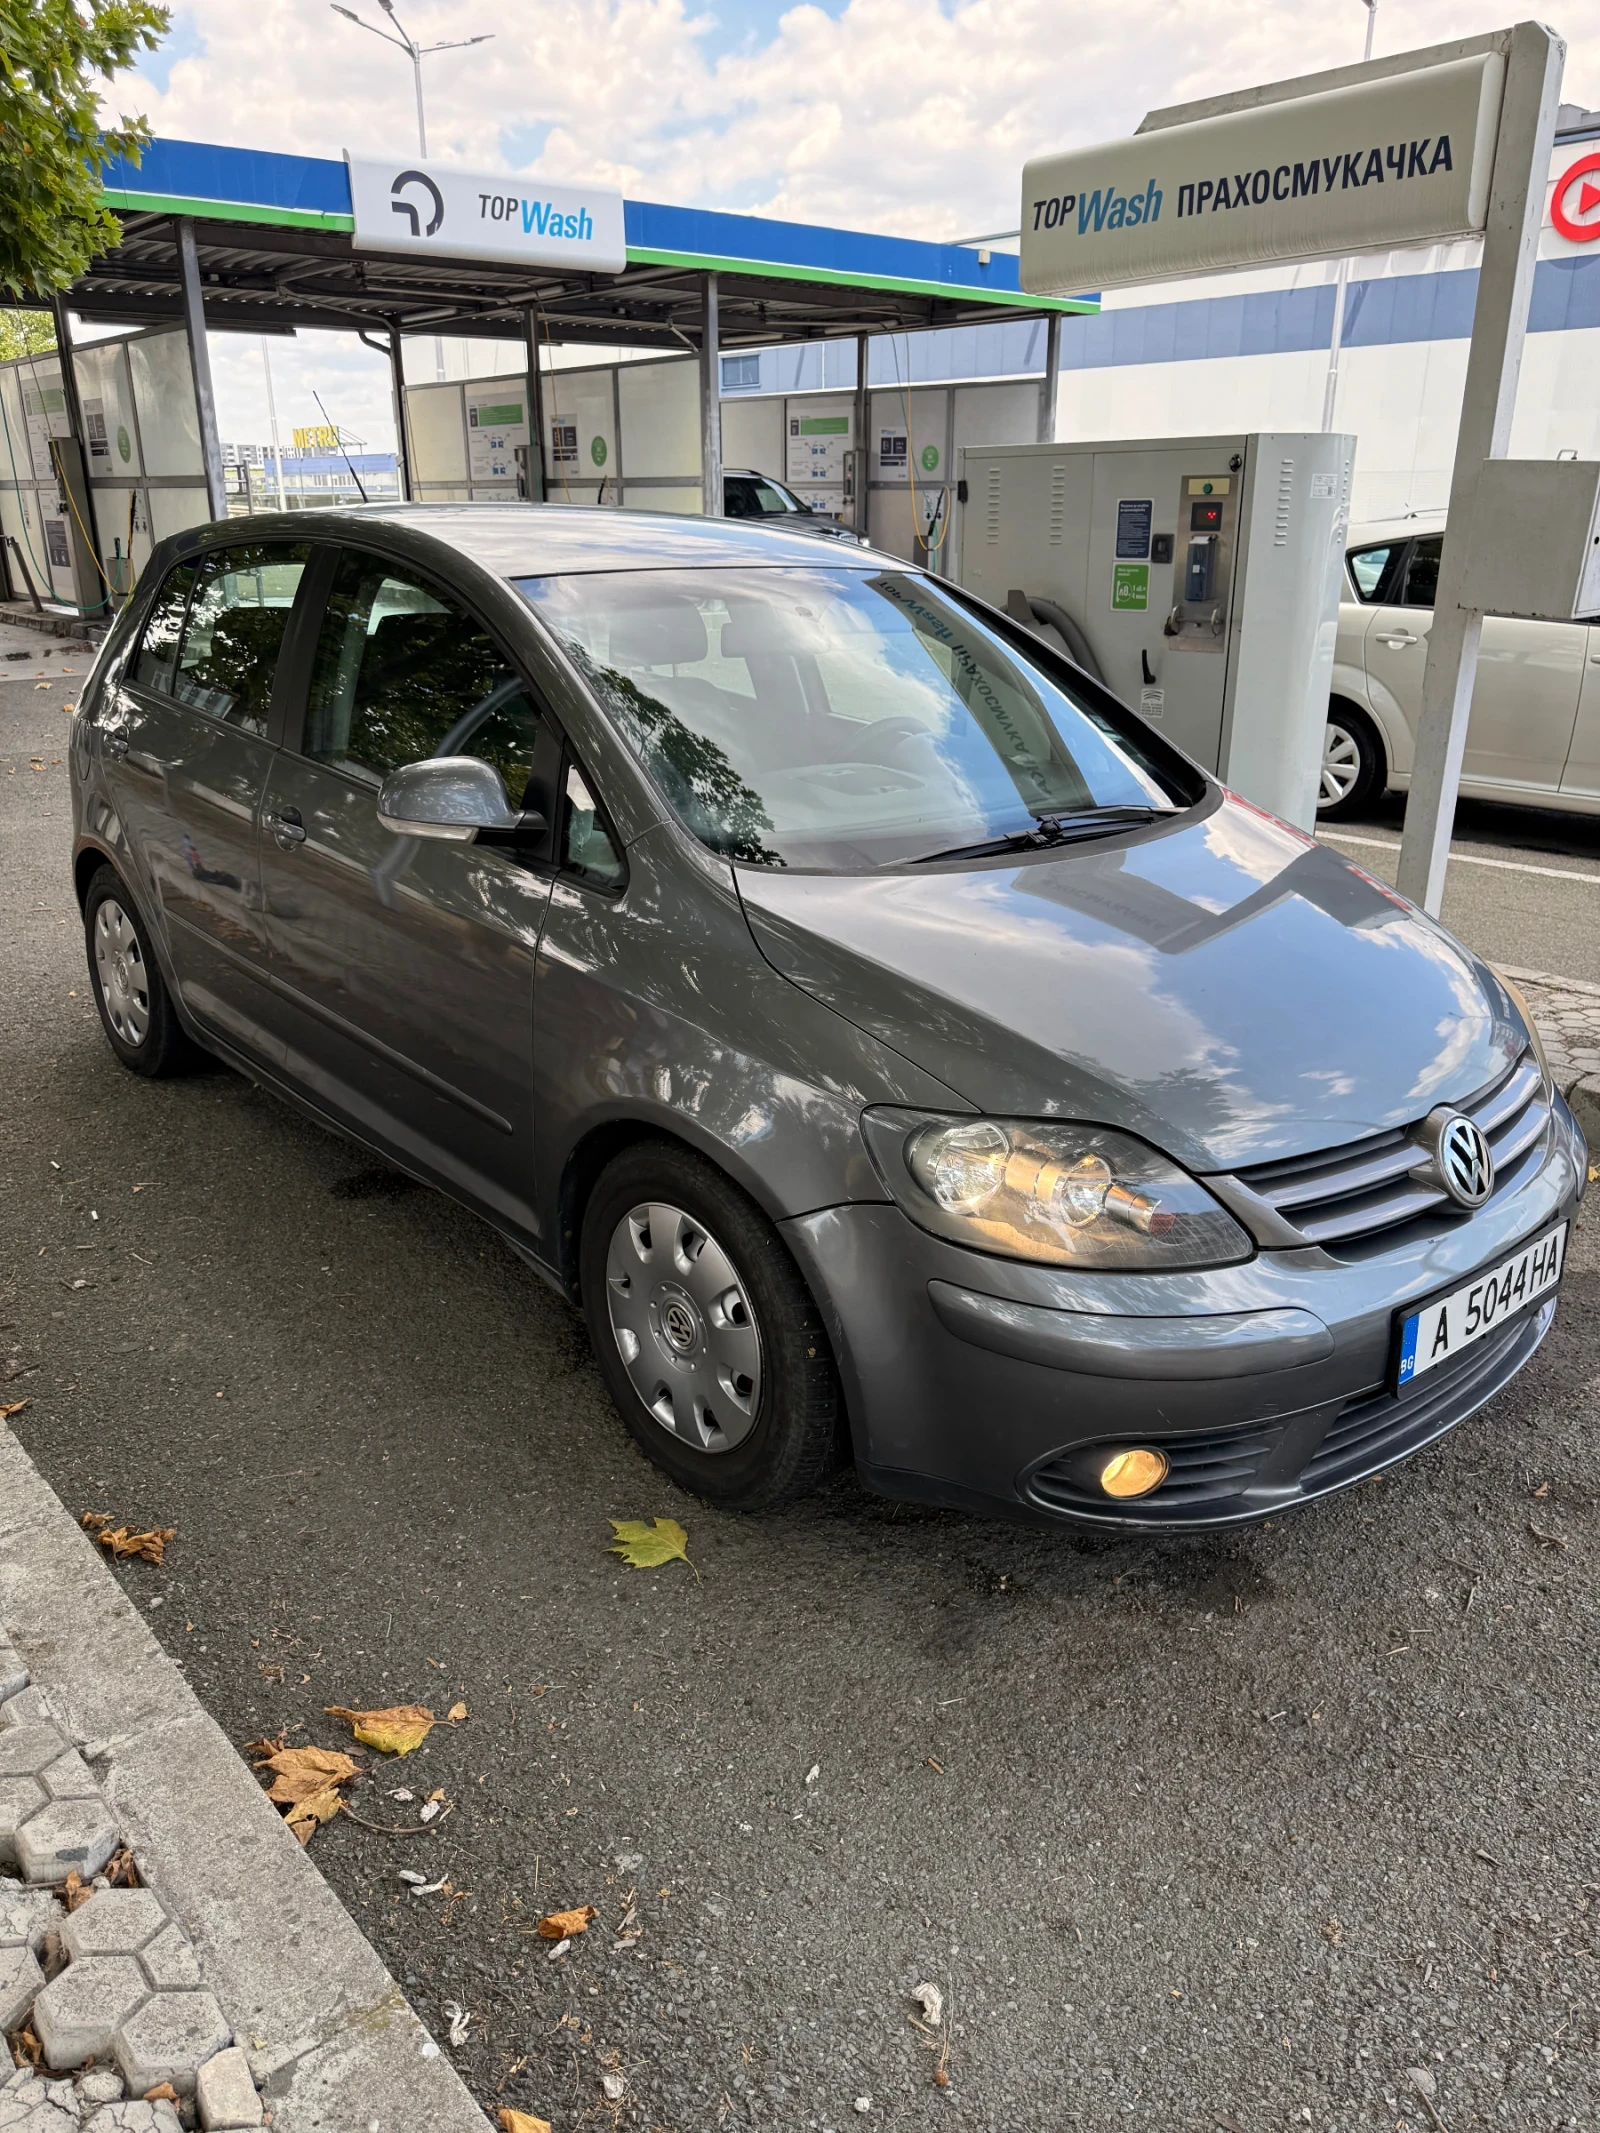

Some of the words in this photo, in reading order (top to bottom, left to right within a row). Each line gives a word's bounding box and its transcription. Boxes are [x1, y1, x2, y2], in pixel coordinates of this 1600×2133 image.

[1177, 135, 1454, 218] ПРАХОСМУКАЧКА
[292, 426, 339, 448] METRO
[1400, 1355, 1414, 1375] BG
